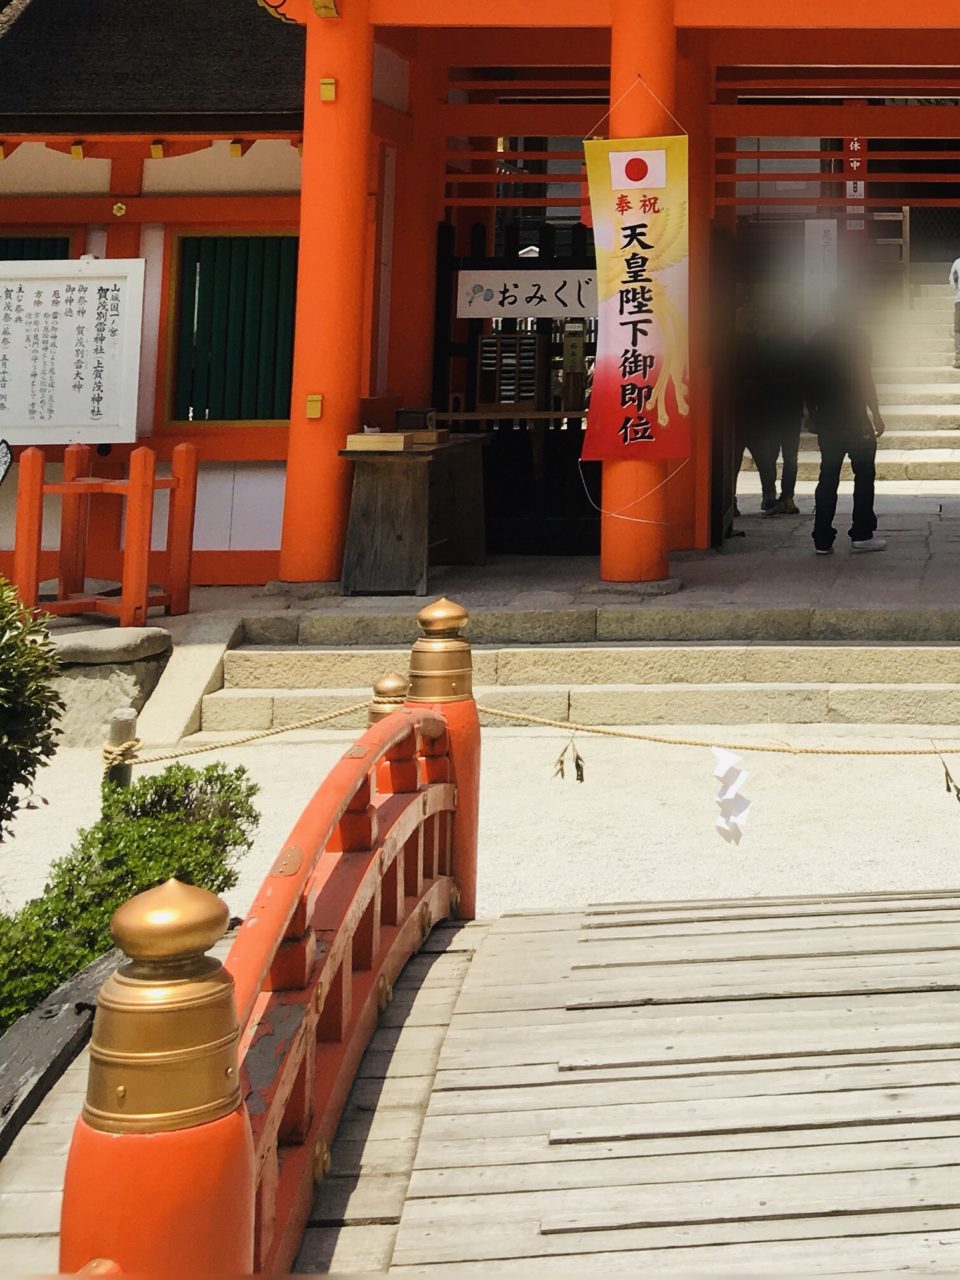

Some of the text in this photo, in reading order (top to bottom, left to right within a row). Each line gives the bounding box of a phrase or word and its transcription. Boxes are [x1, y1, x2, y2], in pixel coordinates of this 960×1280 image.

[615, 194, 660, 216] 奉祝
[498, 277, 592, 308] おみくじ
[72, 324, 85, 393] 賀茂別雷大神
[618, 222, 655, 445] 天皇陛下御即位
